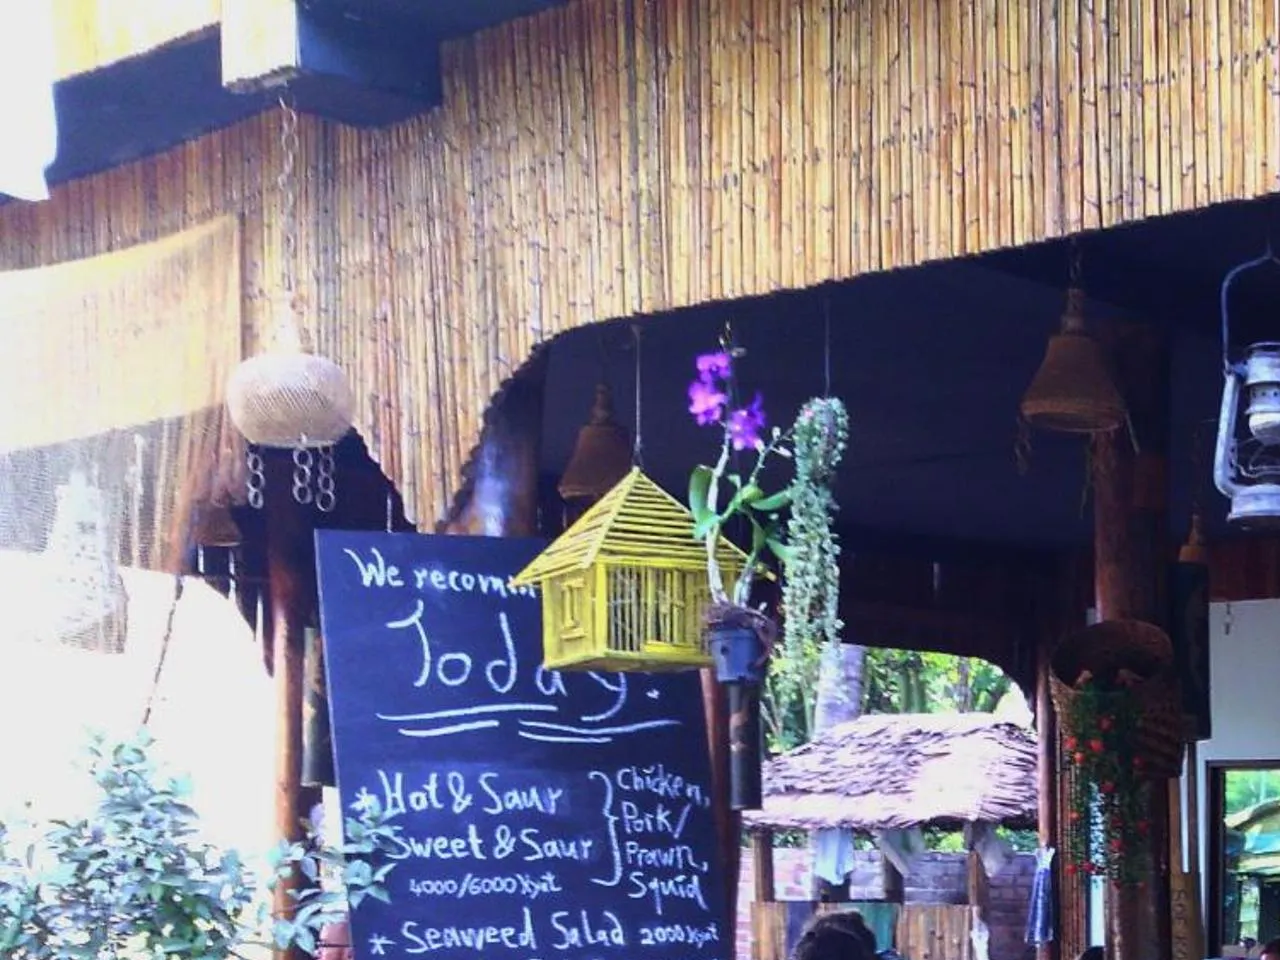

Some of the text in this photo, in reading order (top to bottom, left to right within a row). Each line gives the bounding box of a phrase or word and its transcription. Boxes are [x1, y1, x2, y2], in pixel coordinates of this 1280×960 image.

[344, 548, 404, 588] We
[377, 769, 445, 815] Hot
[448, 771, 473, 815] &
[385, 824, 487, 860] Sweet
[493, 824, 517, 860] &
[627, 871, 709, 915] Squid
[401, 906, 538, 954] Seaweed
[551, 909, 625, 950] Salad
